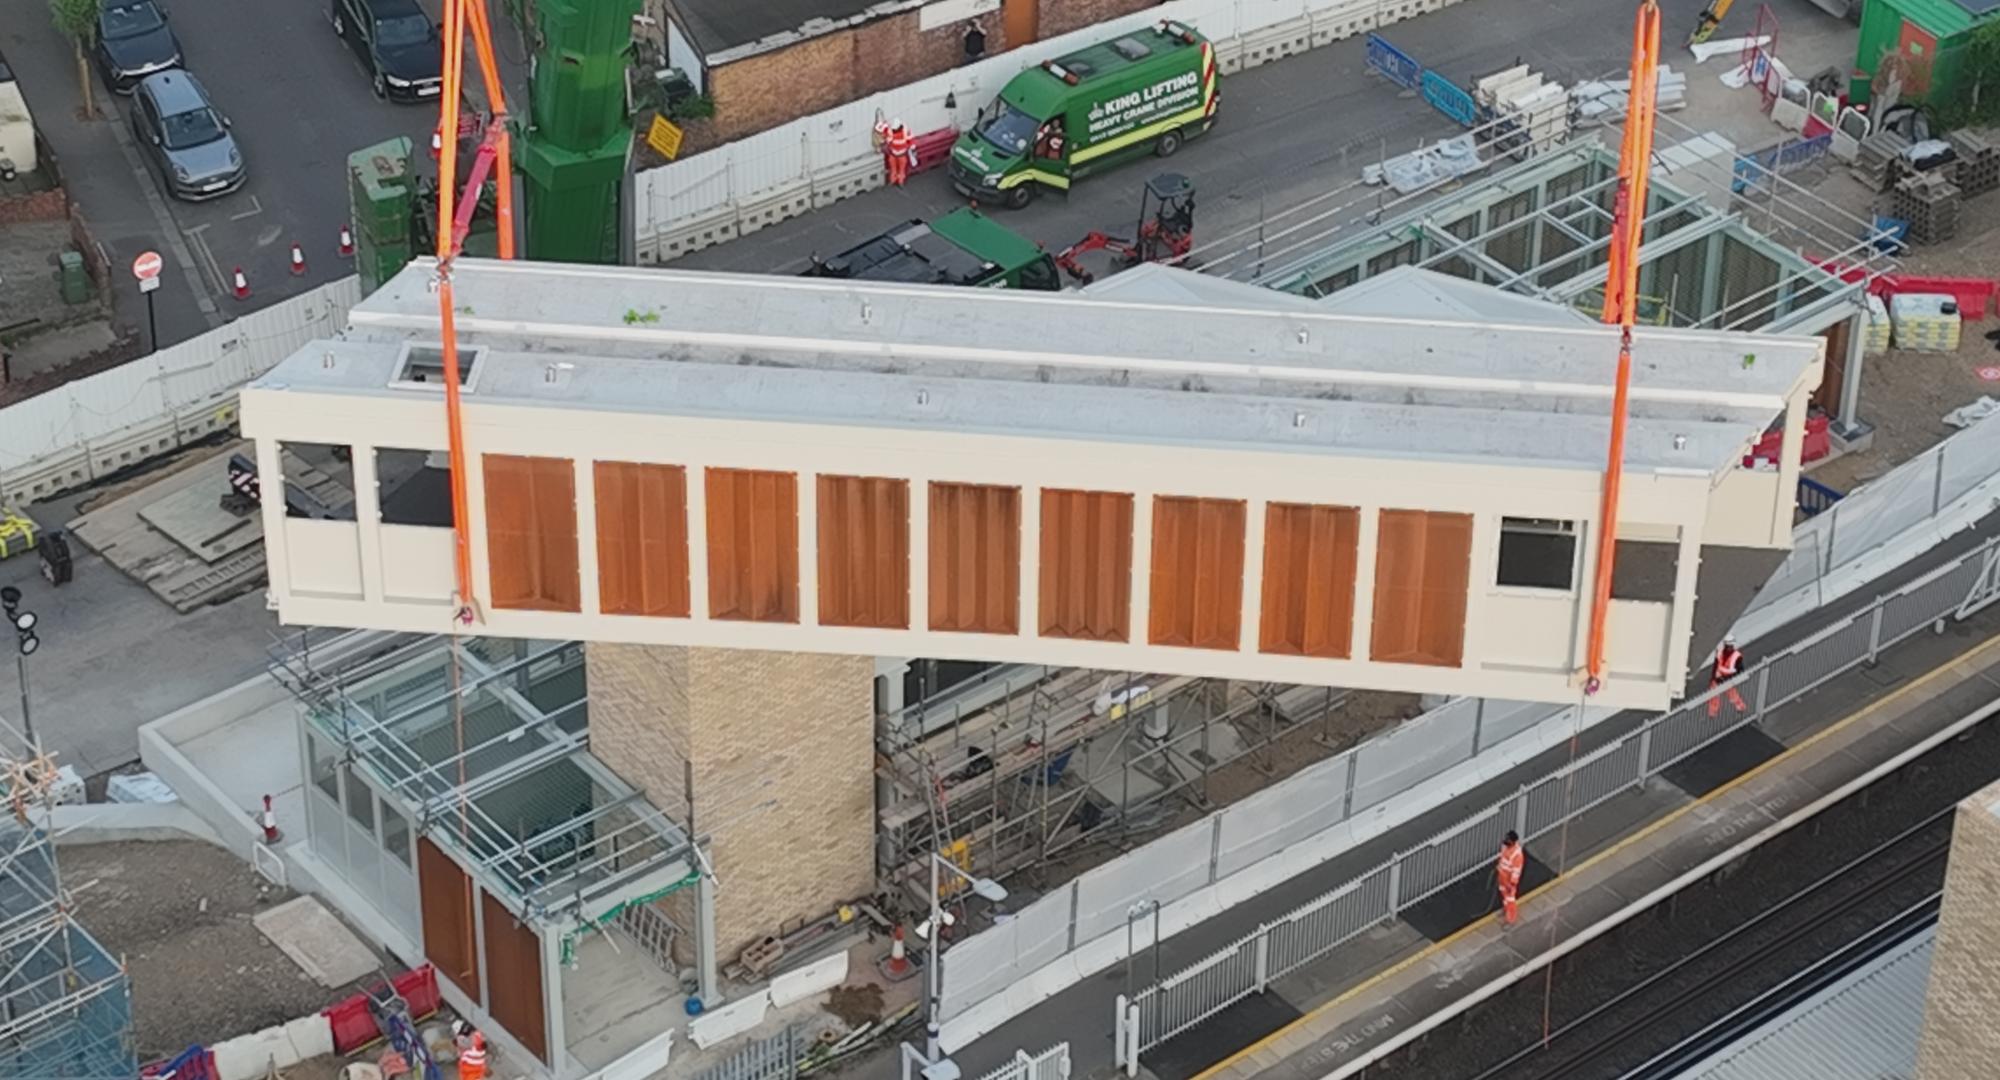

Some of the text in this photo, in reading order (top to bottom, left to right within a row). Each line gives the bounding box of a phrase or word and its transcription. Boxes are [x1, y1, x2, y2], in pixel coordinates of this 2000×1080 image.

[1089, 114, 1121, 133] HEAVY
[1123, 102, 1156, 120] CRANE
[1157, 86, 1199, 108] DIVISION
[1104, 92, 1141, 115] KING
[1143, 71, 1198, 101] LIFTING
